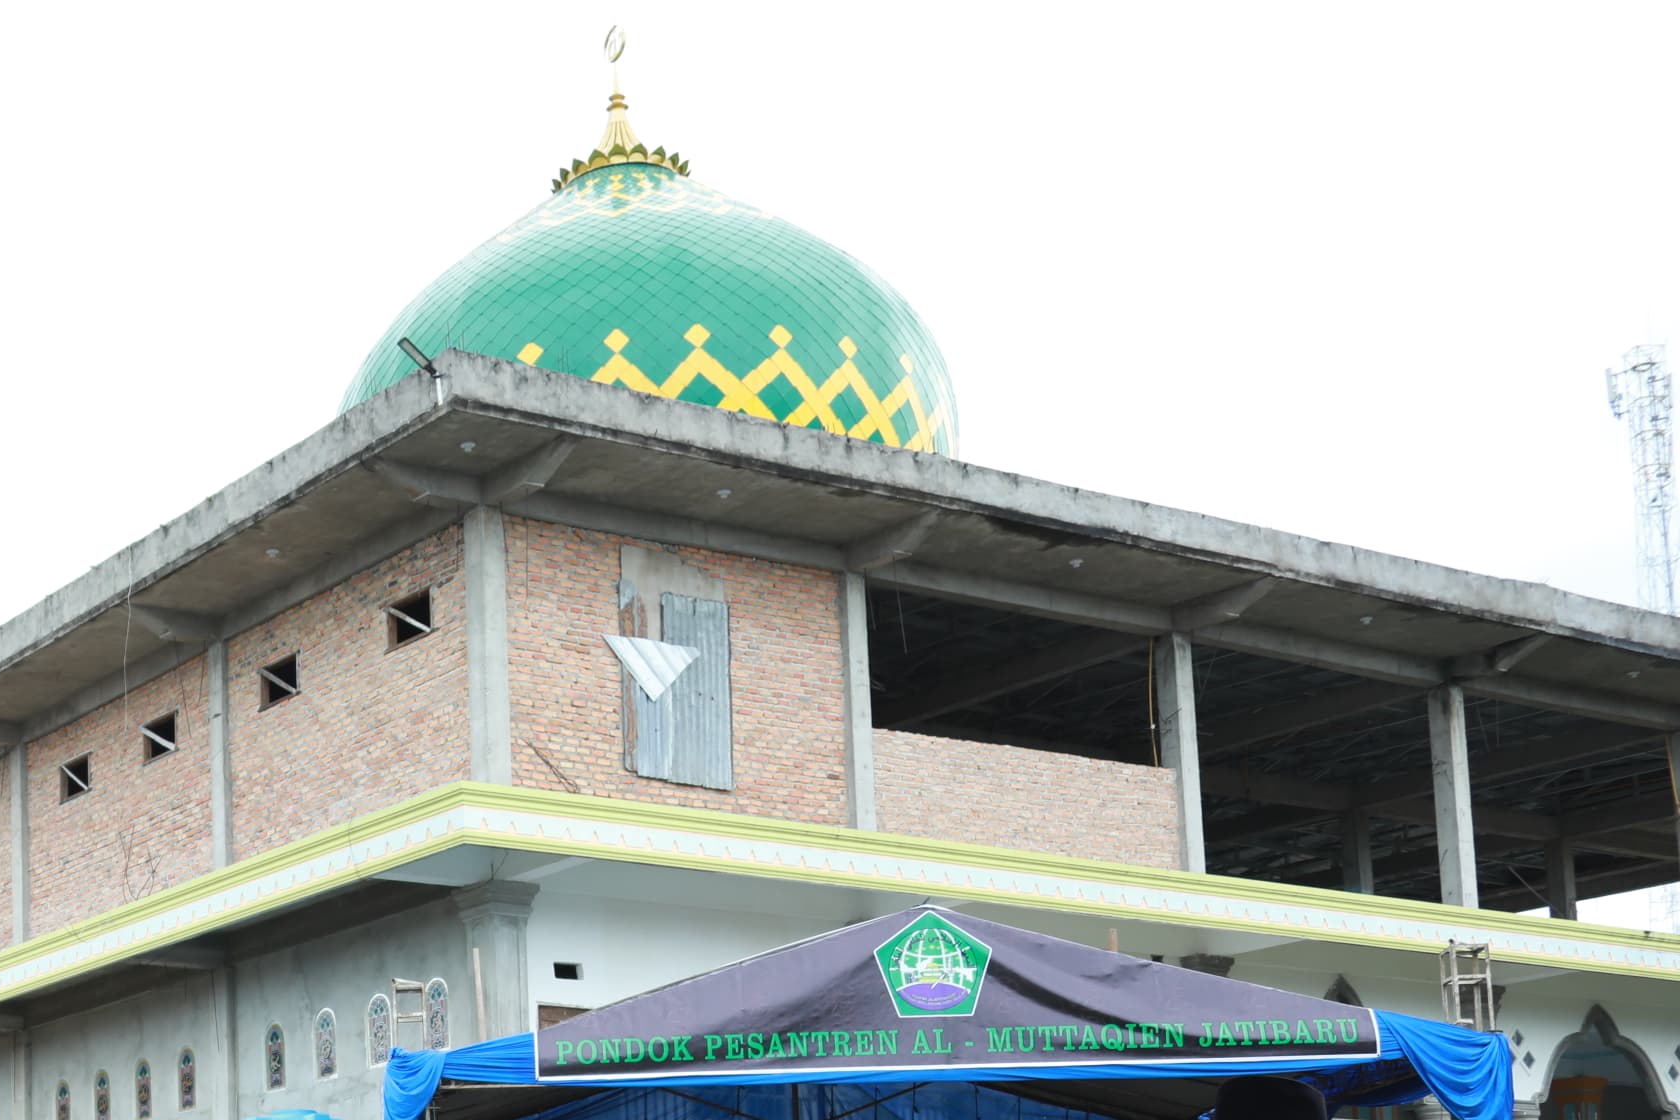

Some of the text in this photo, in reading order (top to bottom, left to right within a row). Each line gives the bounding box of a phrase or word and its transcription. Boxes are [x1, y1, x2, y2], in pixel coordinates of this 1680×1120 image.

[555, 1035, 694, 1066] PONDOK
[704, 1029, 899, 1061] PESANTREN
[911, 1028, 953, 1055] AL
[986, 1022, 1186, 1054] MUTTAQIEN
[1198, 1017, 1360, 1048] JATIBARU
